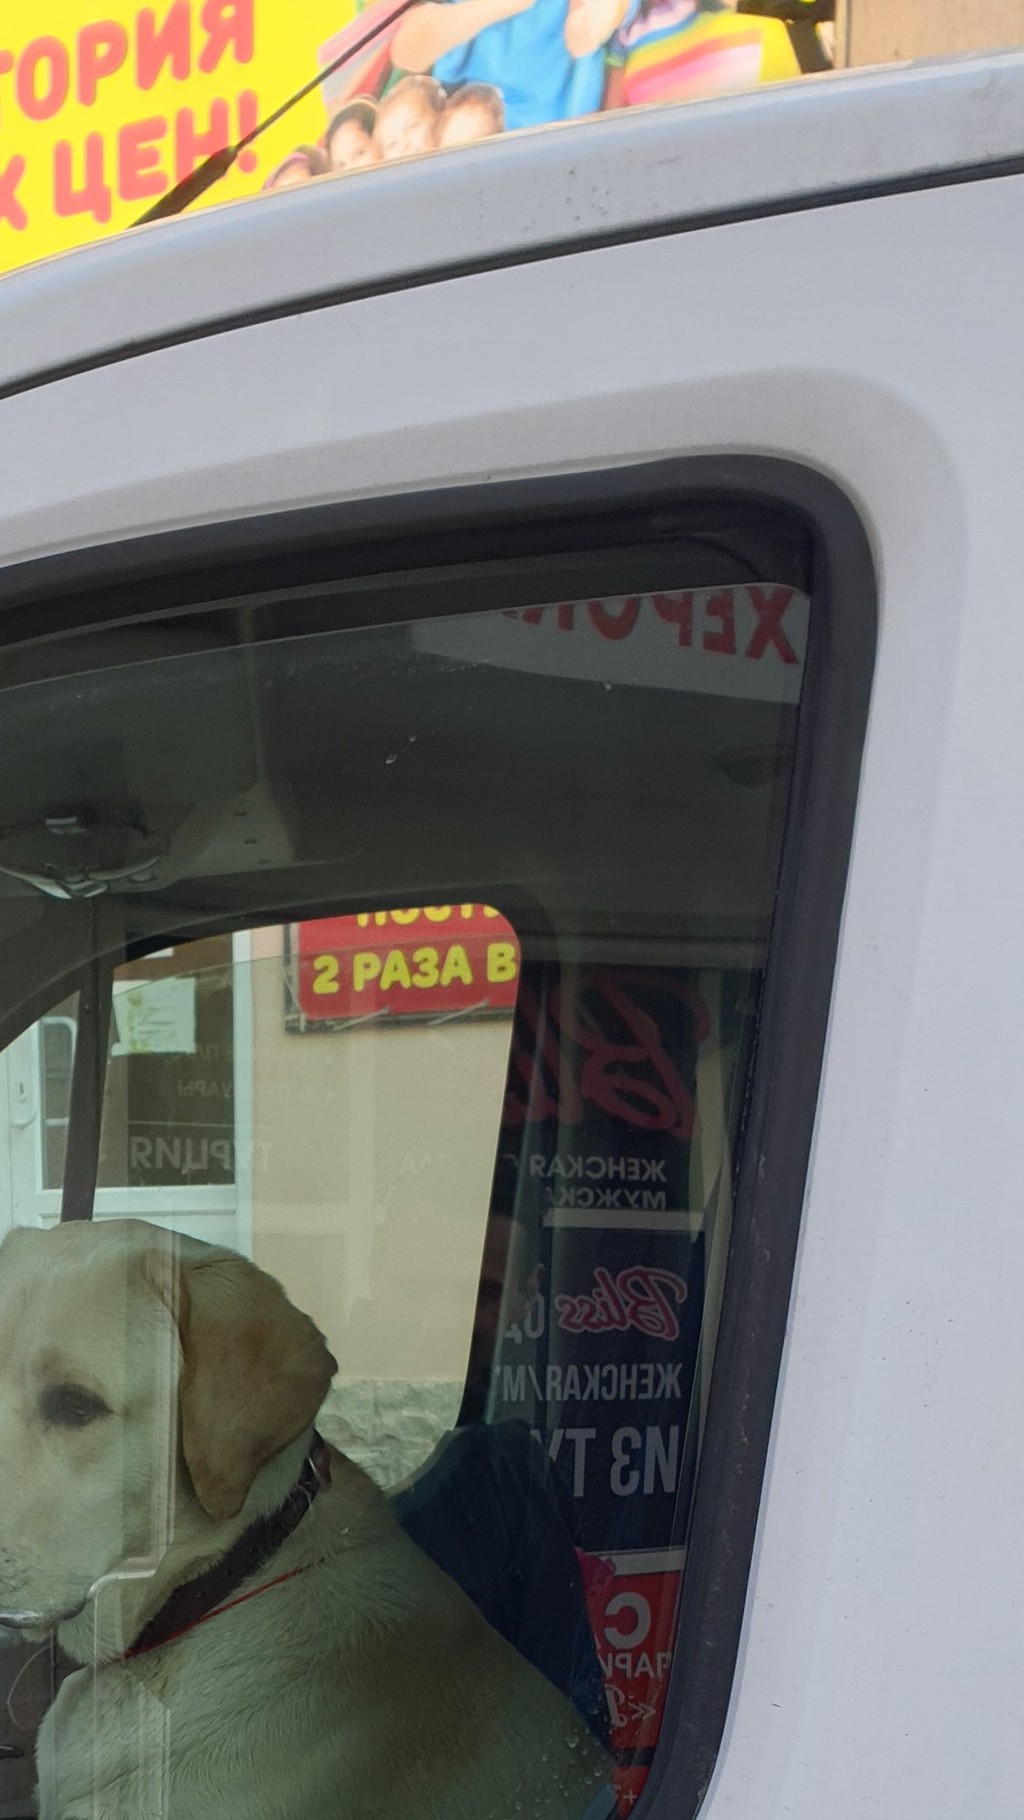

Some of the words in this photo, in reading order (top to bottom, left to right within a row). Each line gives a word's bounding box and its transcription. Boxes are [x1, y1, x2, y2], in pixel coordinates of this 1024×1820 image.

[52, 89, 259, 225] ЦЕН!
[312, 954, 339, 994] 2
[353, 945, 473, 993] РАЗА
[487, 942, 517, 983] В
